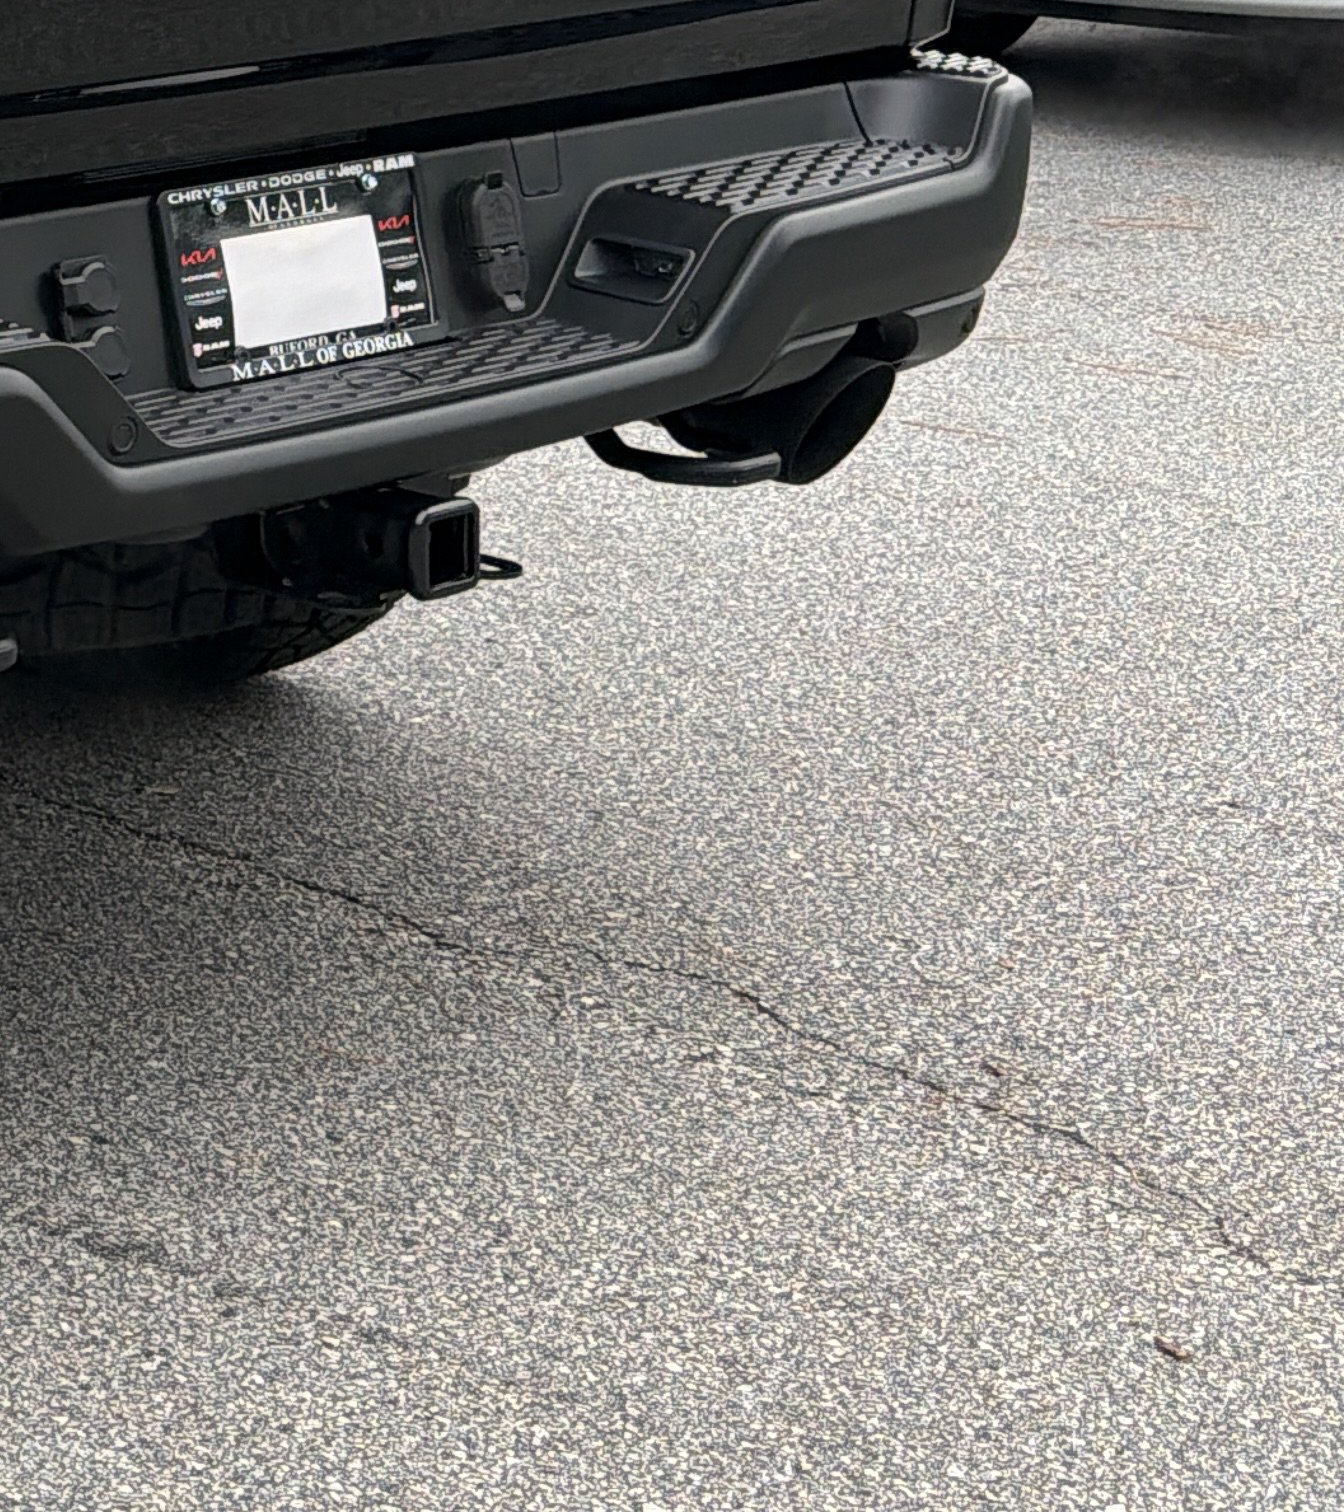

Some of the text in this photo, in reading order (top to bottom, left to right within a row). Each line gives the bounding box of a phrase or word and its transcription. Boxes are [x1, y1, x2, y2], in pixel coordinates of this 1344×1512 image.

[167, 154, 415, 205] CHRYSLER DODGE Jeep RAM
[316, 346, 338, 365] OF
[342, 332, 414, 359] GEORGIA
[335, 330, 357, 345] GA
